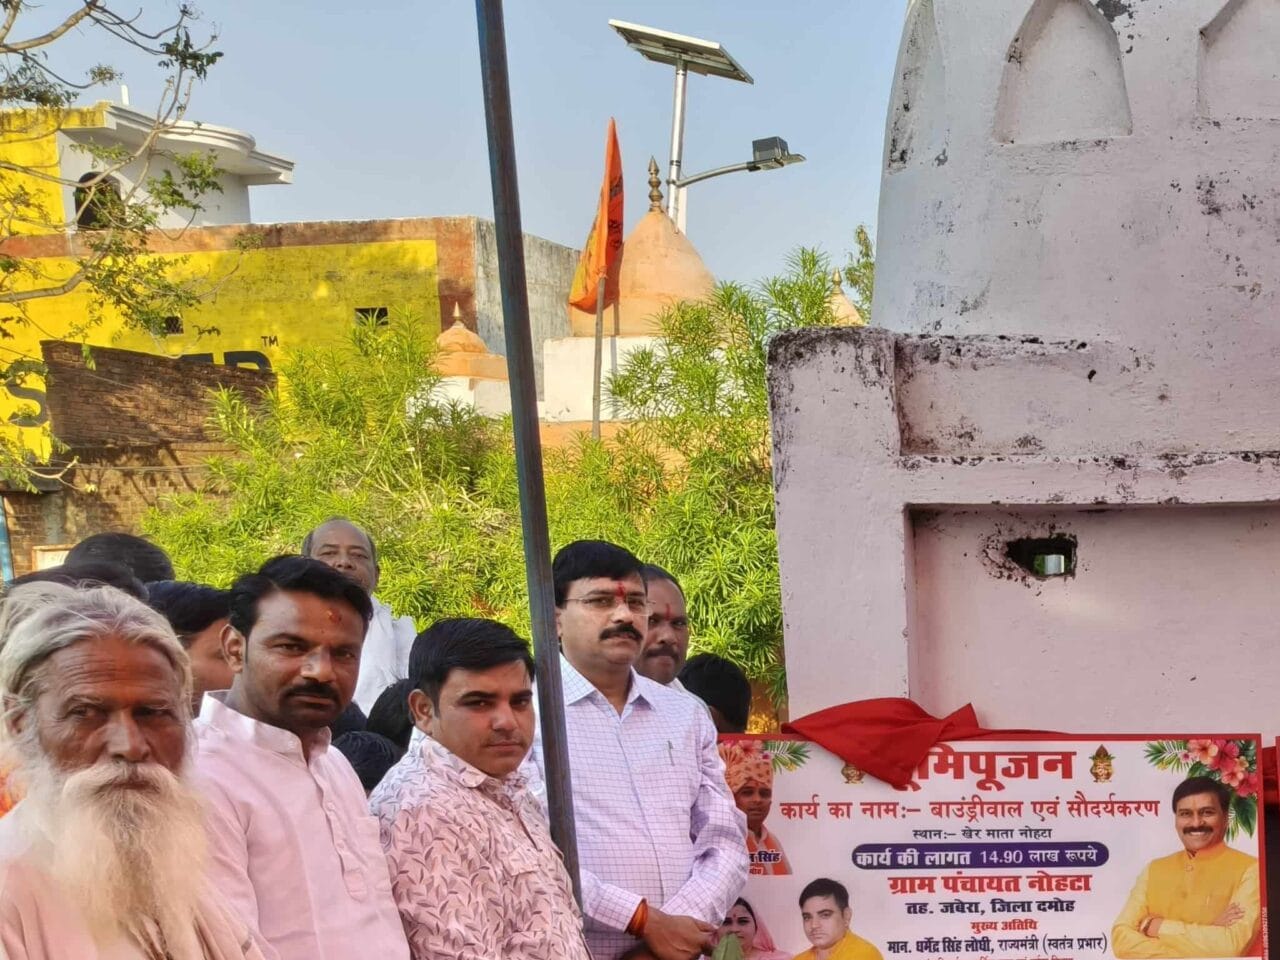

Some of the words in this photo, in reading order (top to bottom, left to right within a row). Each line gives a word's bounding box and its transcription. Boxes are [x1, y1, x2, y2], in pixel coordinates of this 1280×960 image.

[260, 335, 279, 347] TM
[780, 794, 820, 820] कार्य
[828, 802, 853, 819] का
[1031, 796, 1060, 822] एवं
[961, 826, 982, 839] खेर
[986, 828, 1014, 839] माता
[1019, 825, 1052, 840] नोहटा
[758, 850, 781, 863] सिंह
[856, 847, 892, 866] कार्य
[896, 848, 920, 866] की
[924, 851, 972, 865] लागत
[980, 850, 1023, 863] 14.90
[1028, 849, 1060, 862] लाख
[888, 876, 937, 895] ग्राम
[941, 871, 1022, 893] पंचायत
[1026, 870, 1093, 892] नोहटा
[990, 898, 1032, 913] जिला
[1035, 897, 1076, 912] दमोह
[970, 921, 998, 934] मुख्य
[1001, 918, 1039, 930] अतिथि
[942, 936, 962, 952] सिंह
[997, 934, 1039, 950] राज्यमंत्री
